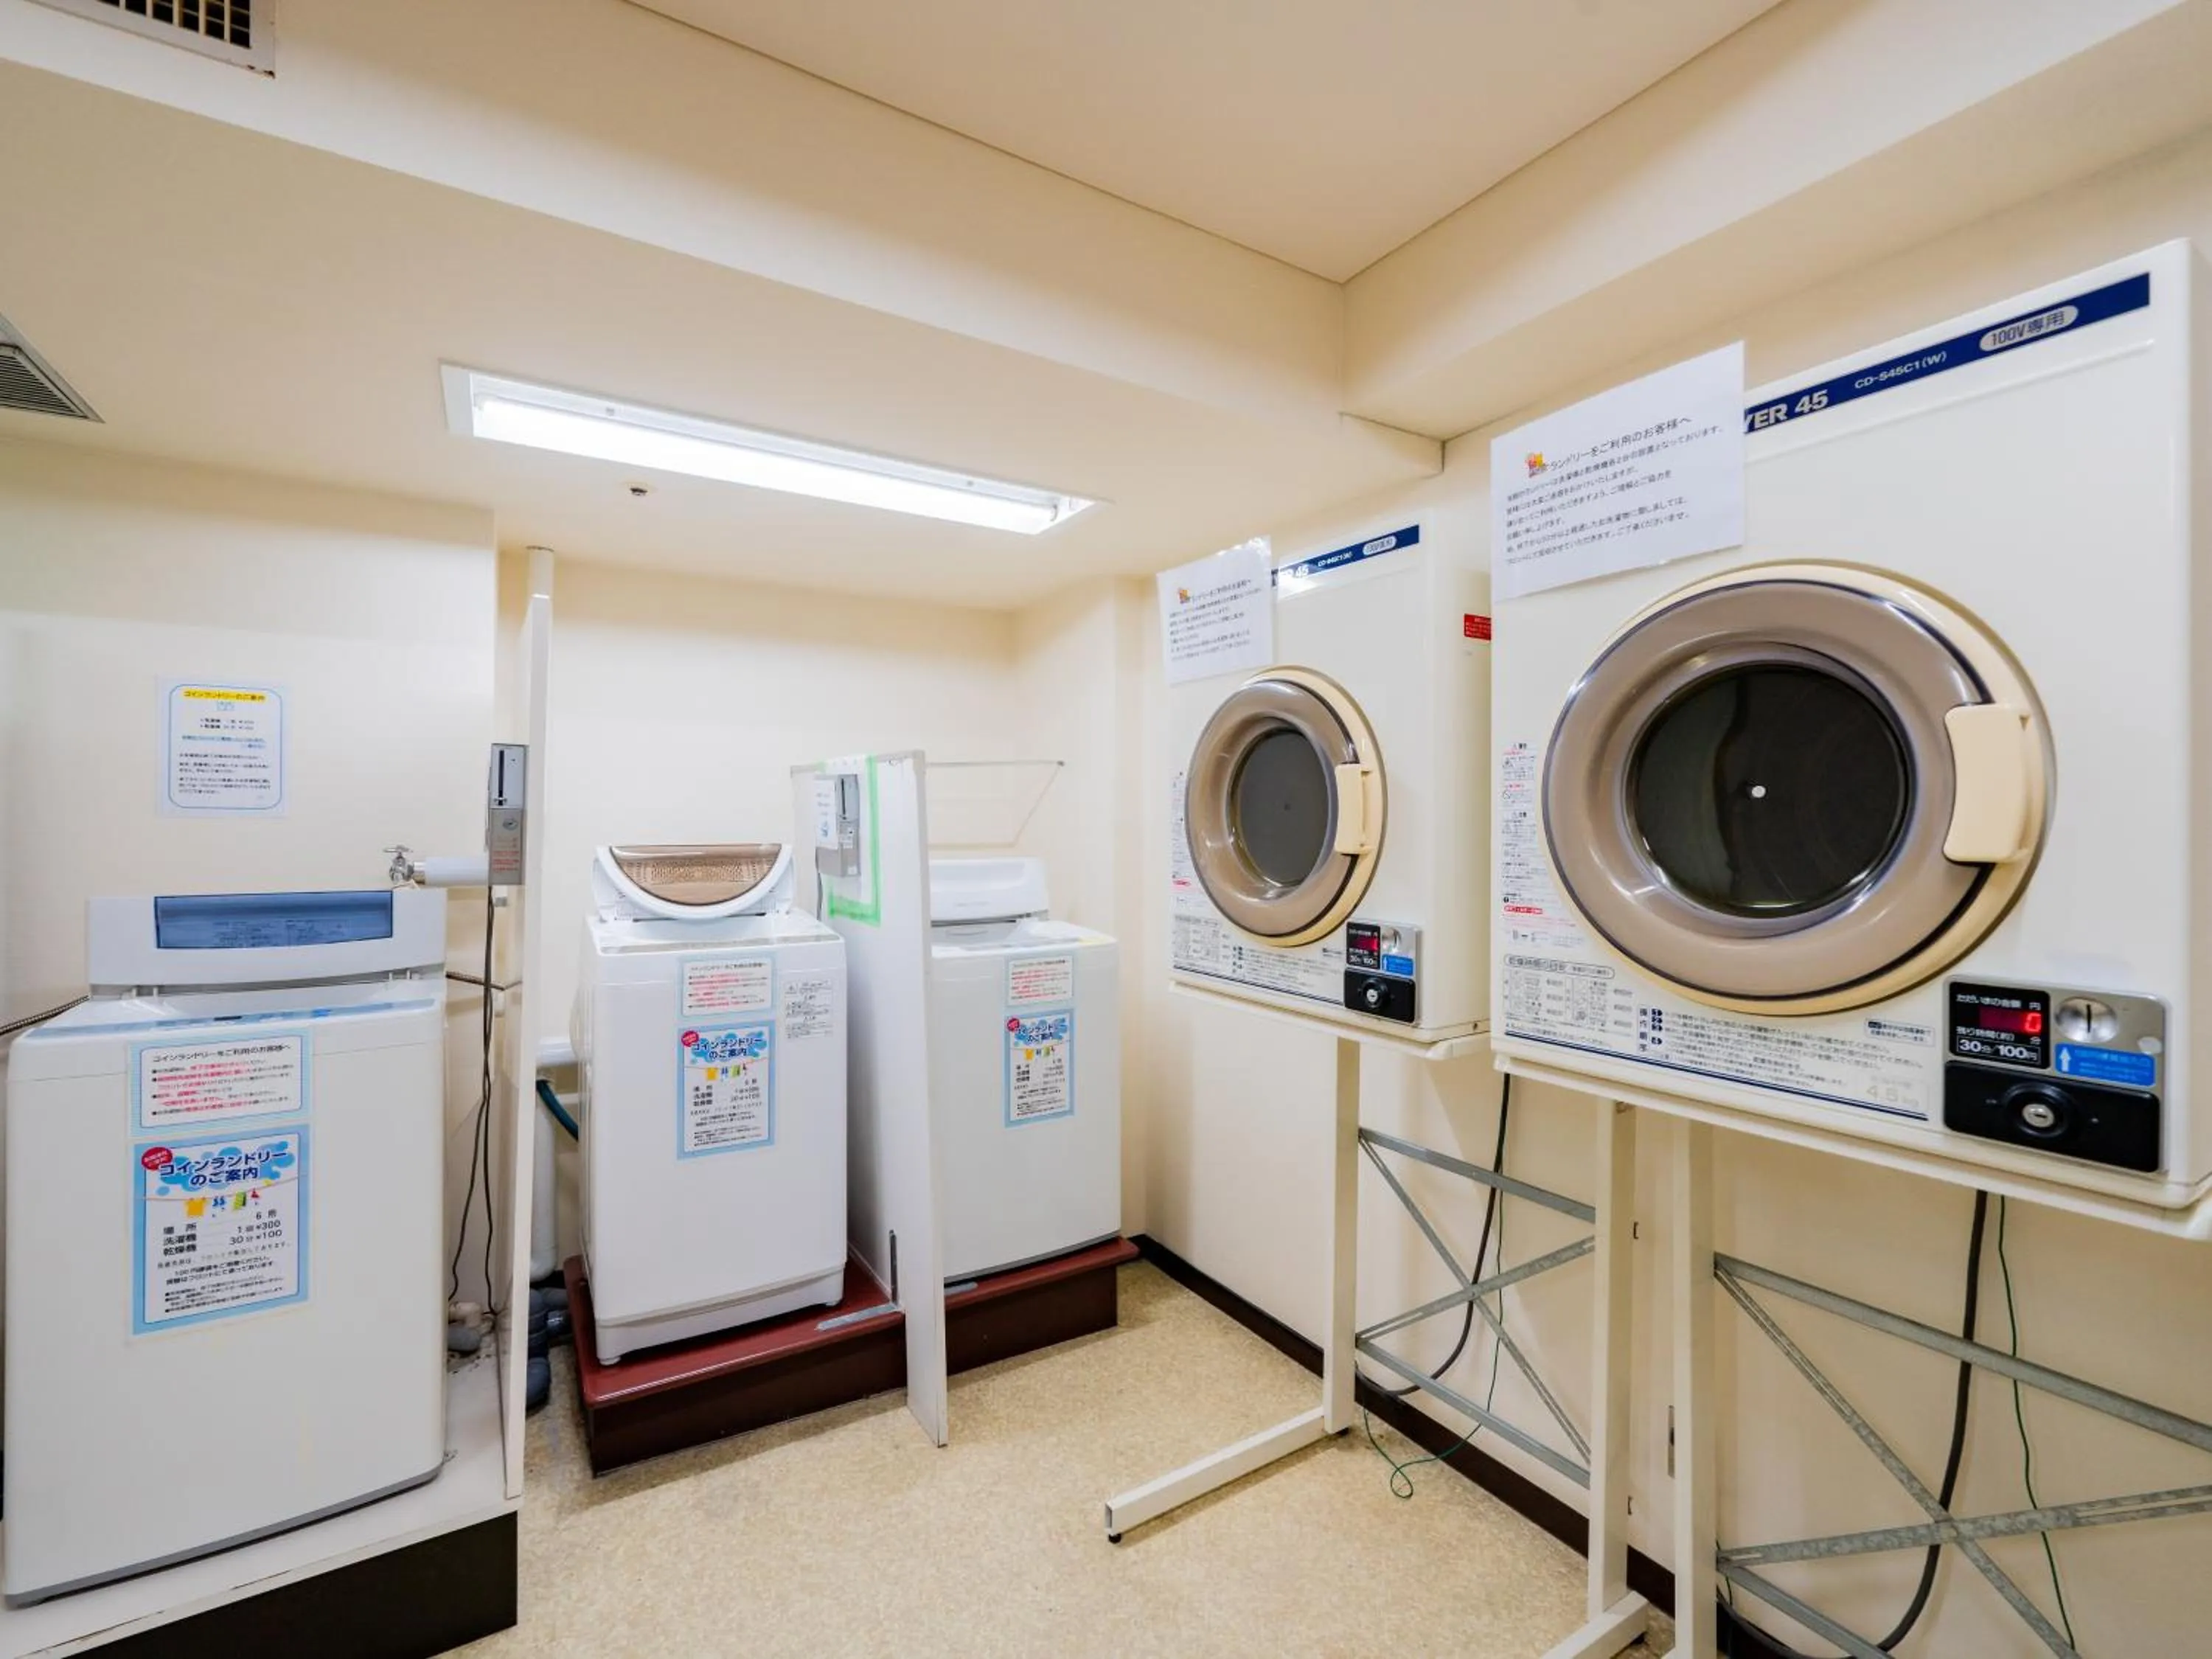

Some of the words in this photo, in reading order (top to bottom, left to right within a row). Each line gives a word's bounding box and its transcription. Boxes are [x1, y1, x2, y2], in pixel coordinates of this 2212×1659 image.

[1992, 310, 2066, 347] 100V専用
[1794, 389, 1829, 414] 45
[2025, 1012, 2042, 1032] 0
[160, 1150, 287, 1176] コインランドリー
[189, 1166, 258, 1186] のご案内
